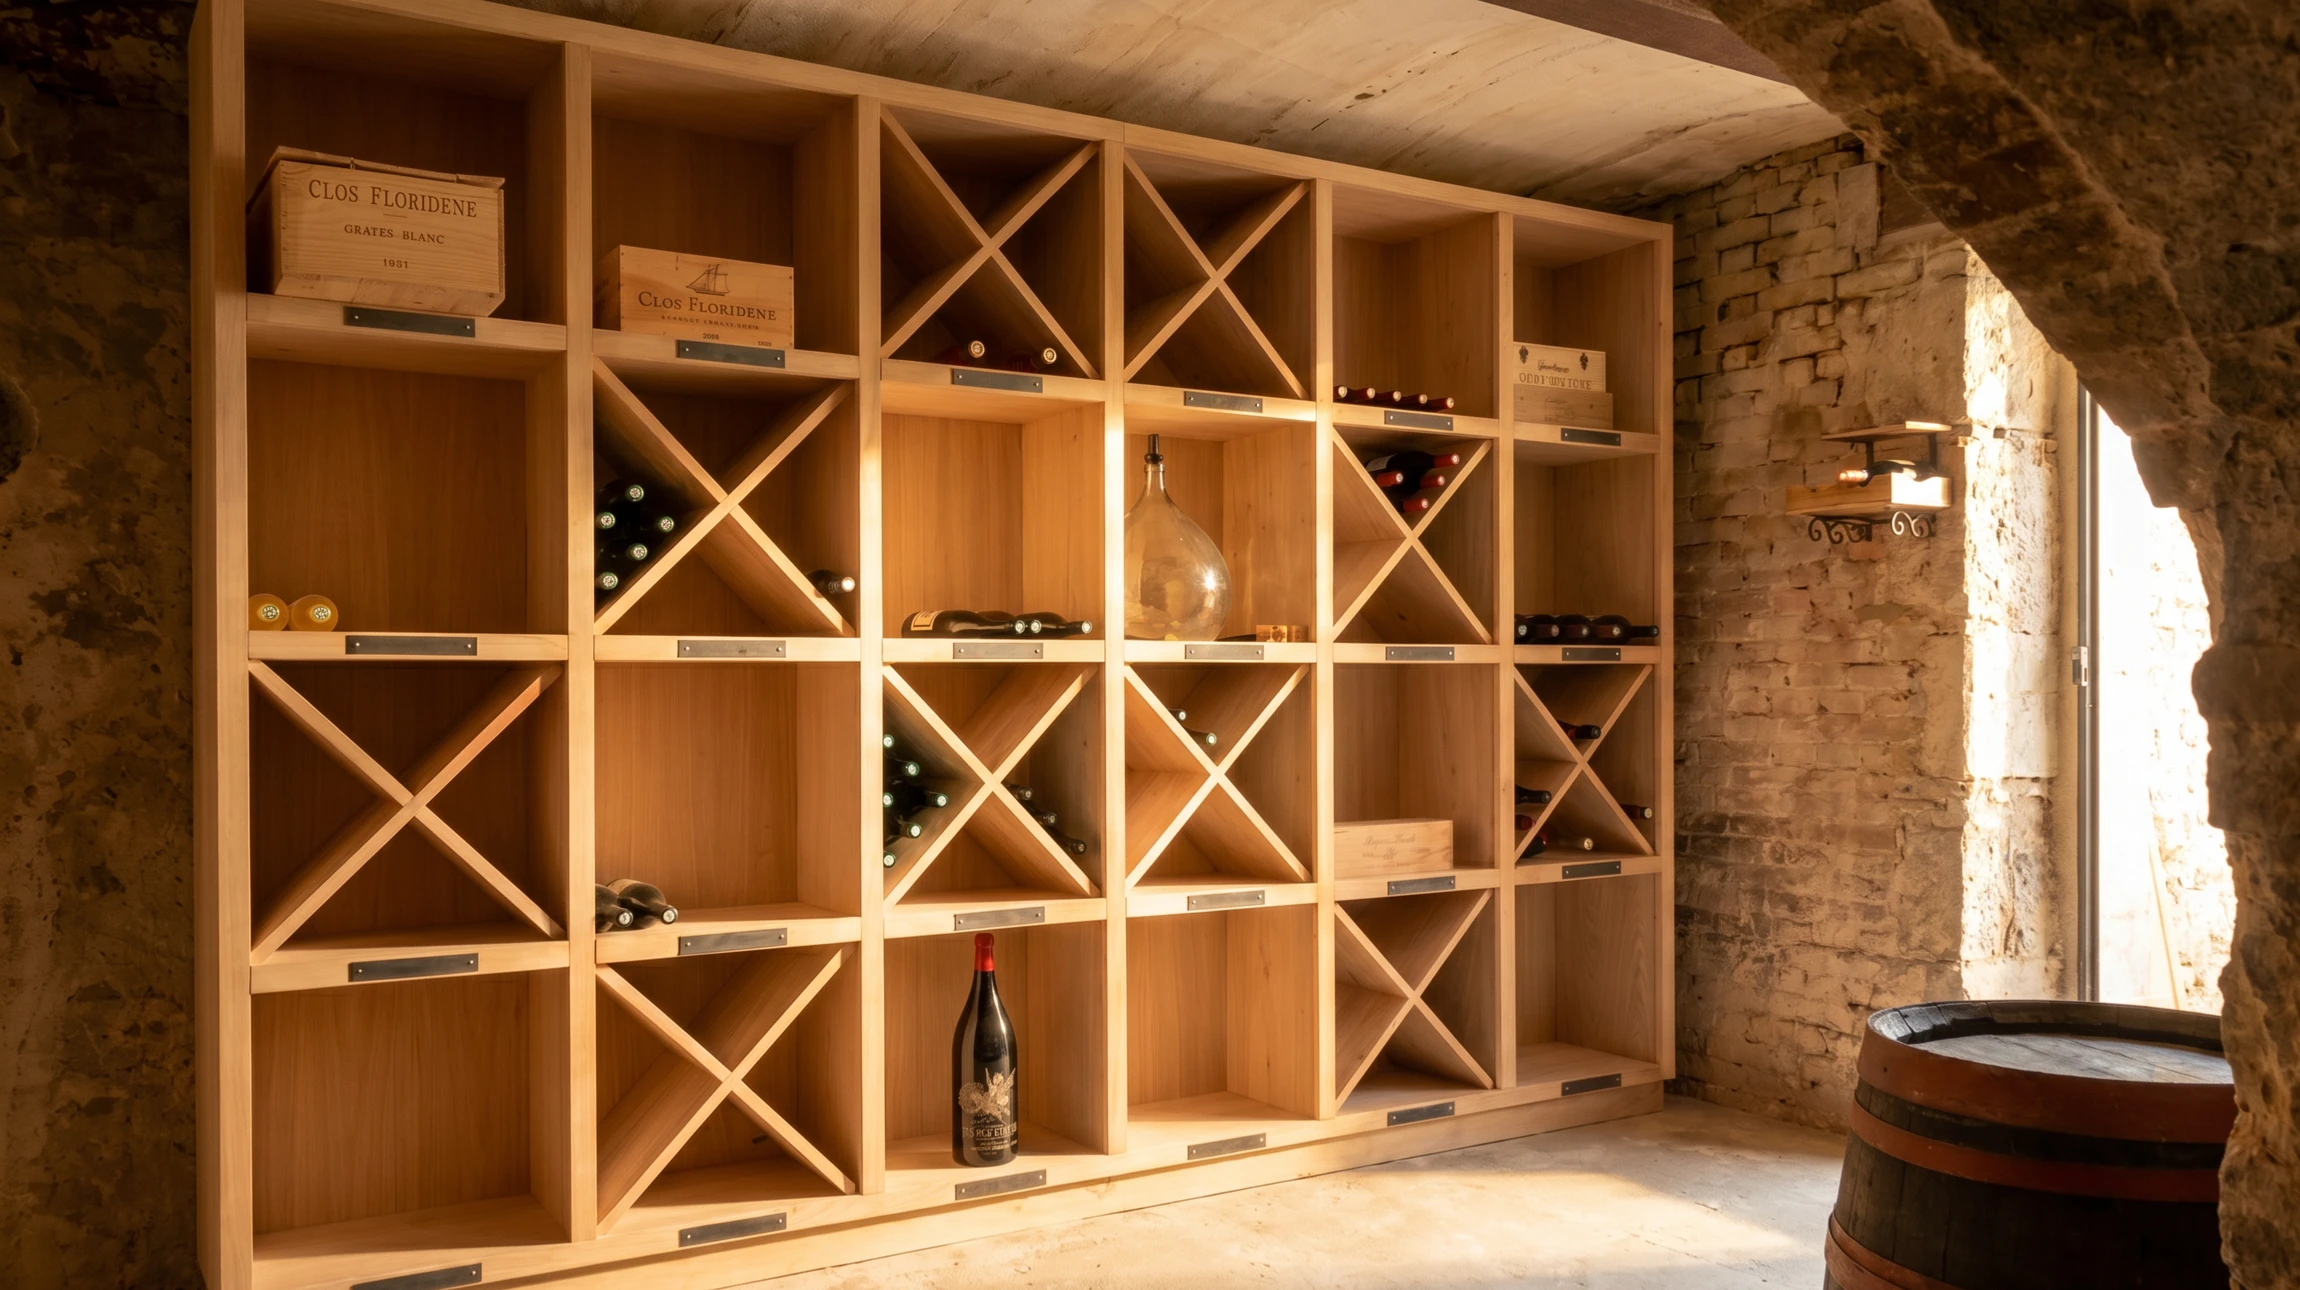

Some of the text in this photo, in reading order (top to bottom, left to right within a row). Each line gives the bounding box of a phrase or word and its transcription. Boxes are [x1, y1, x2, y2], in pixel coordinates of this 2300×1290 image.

[308, 179, 477, 218] CLOS FLORIDENE
[402, 230, 445, 244] BLANC
[638, 291, 776, 321] CLOS FLORIDENE
